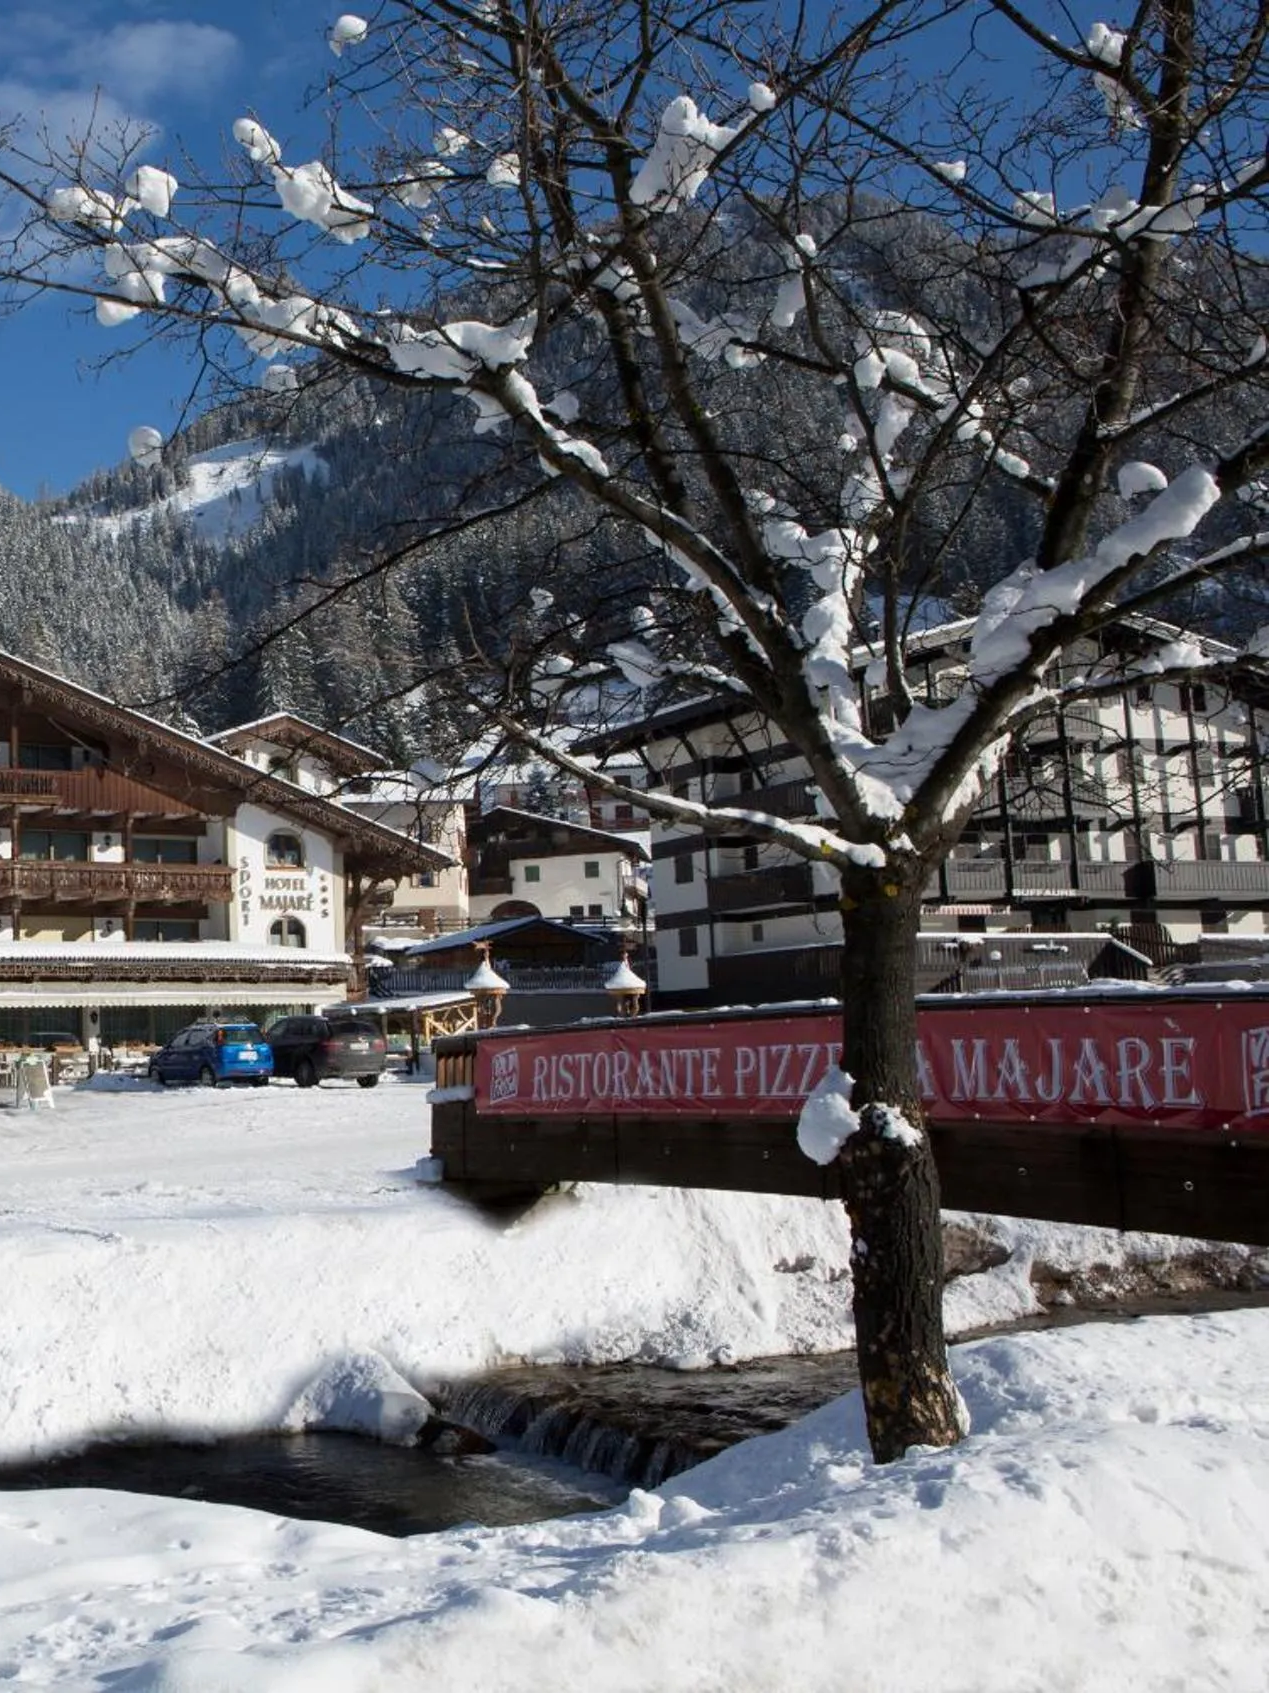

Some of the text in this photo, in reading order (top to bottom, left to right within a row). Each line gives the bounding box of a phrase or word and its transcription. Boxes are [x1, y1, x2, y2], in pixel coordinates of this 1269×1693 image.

[264, 878, 305, 890] HOTEL
[531, 1047, 722, 1101] RISTORANTE
[950, 1018, 1202, 1113] MAJARÈ
